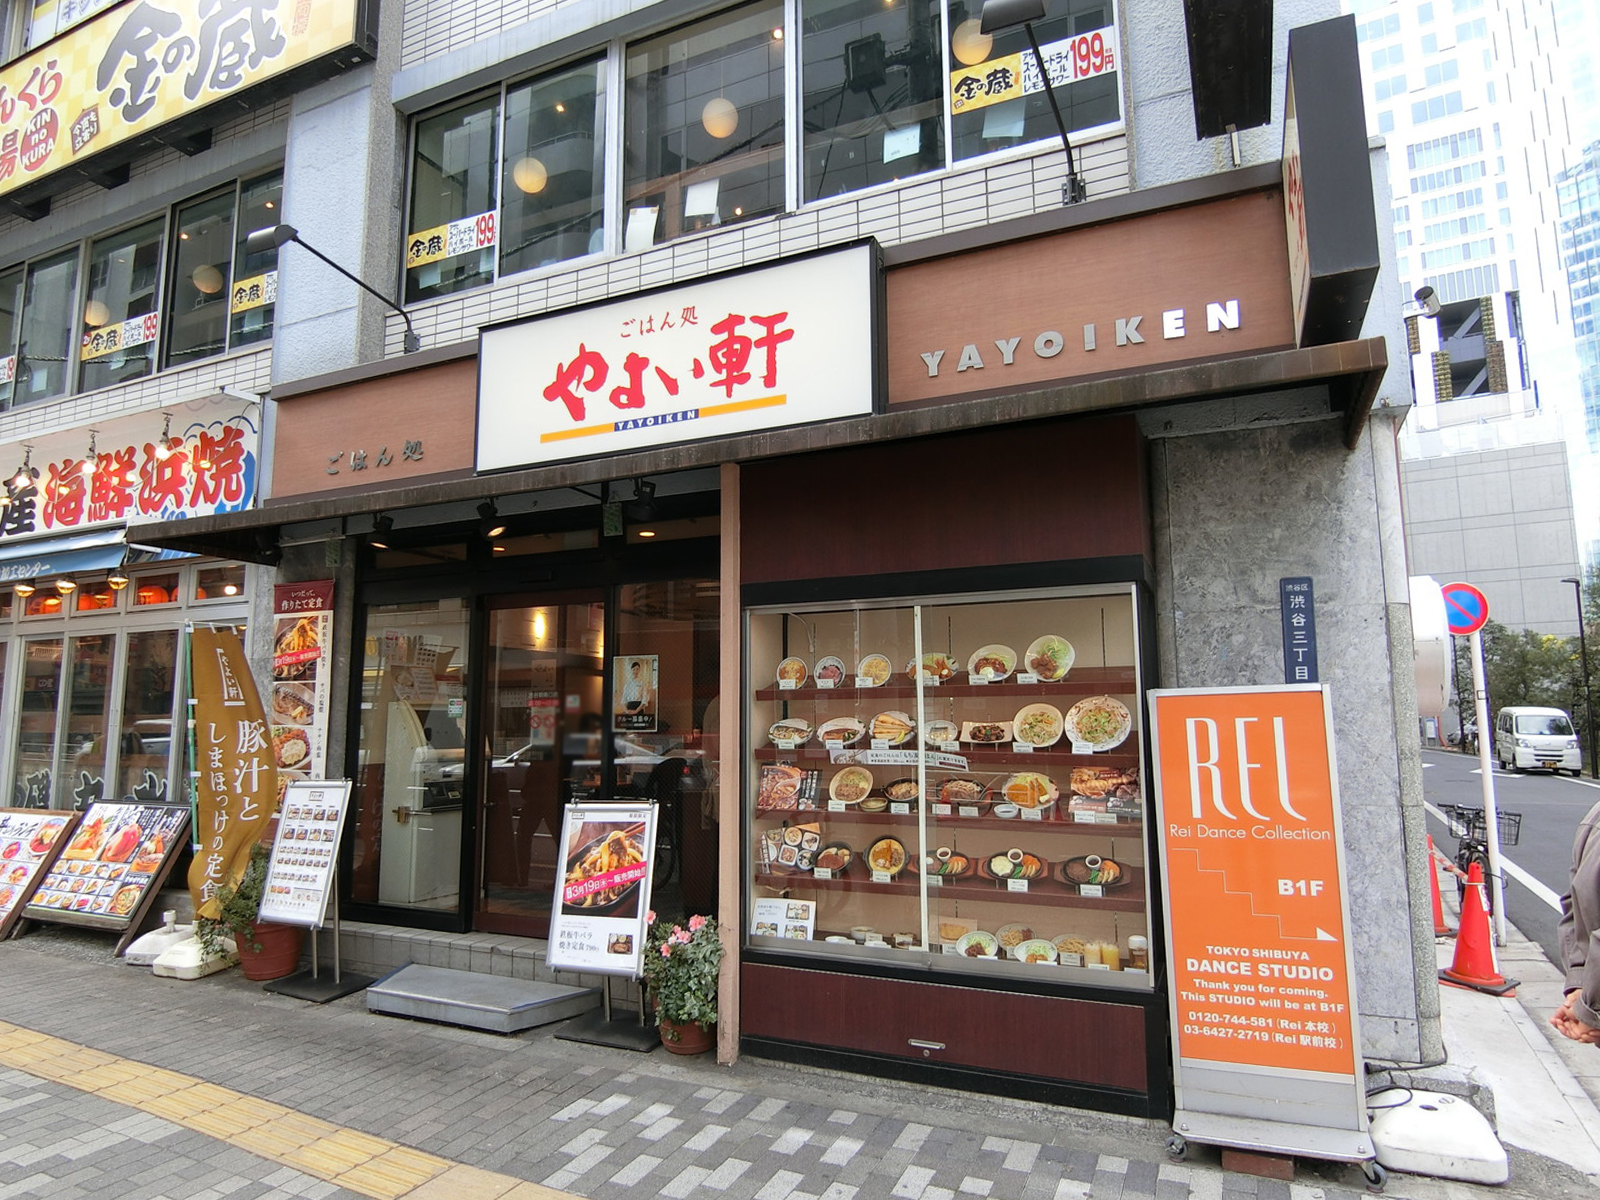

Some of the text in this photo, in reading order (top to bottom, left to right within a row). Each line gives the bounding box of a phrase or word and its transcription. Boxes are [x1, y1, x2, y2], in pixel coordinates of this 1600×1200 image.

[97, 0, 286, 122] 金の蔵
[954, 66, 1013, 100] 金の蔵
[26, 108, 52, 136] KIN
[31, 128, 48, 146] no
[22, 138, 55, 167] KURA
[410, 235, 444, 258] 金の蔵
[620, 305, 699, 338] ごはん処
[920, 299, 1240, 378] YAYOIKEN
[543, 312, 795, 422] やよい軒
[617, 409, 696, 431] YAYOIKEN
[327, 440, 424, 475] ごはん処
[1286, 583, 1309, 592] 渋谷区
[281, 597, 324, 611] 作りたて定食
[1289, 594, 1309, 680] 渋谷三丁目
[221, 655, 239, 699] やよい軒
[233, 718, 270, 821] 豚汁と
[200, 722, 230, 902] しまほっけの定食
[1170, 824, 1331, 841] Rei Dance Collection
[1278, 879, 1324, 897] B1F
[1206, 945, 1310, 961] TOKYO SHIBUYA
[1186, 958, 1334, 982] DANCE STUDIO
[1193, 978, 1328, 999] Thank you for coming.
[1181, 991, 1345, 1013] This STUDIO will be at B1F
[1188, 1011, 1274, 1028] 0120-744-581
[1183, 1025, 1269, 1041] 03-6427-2719
